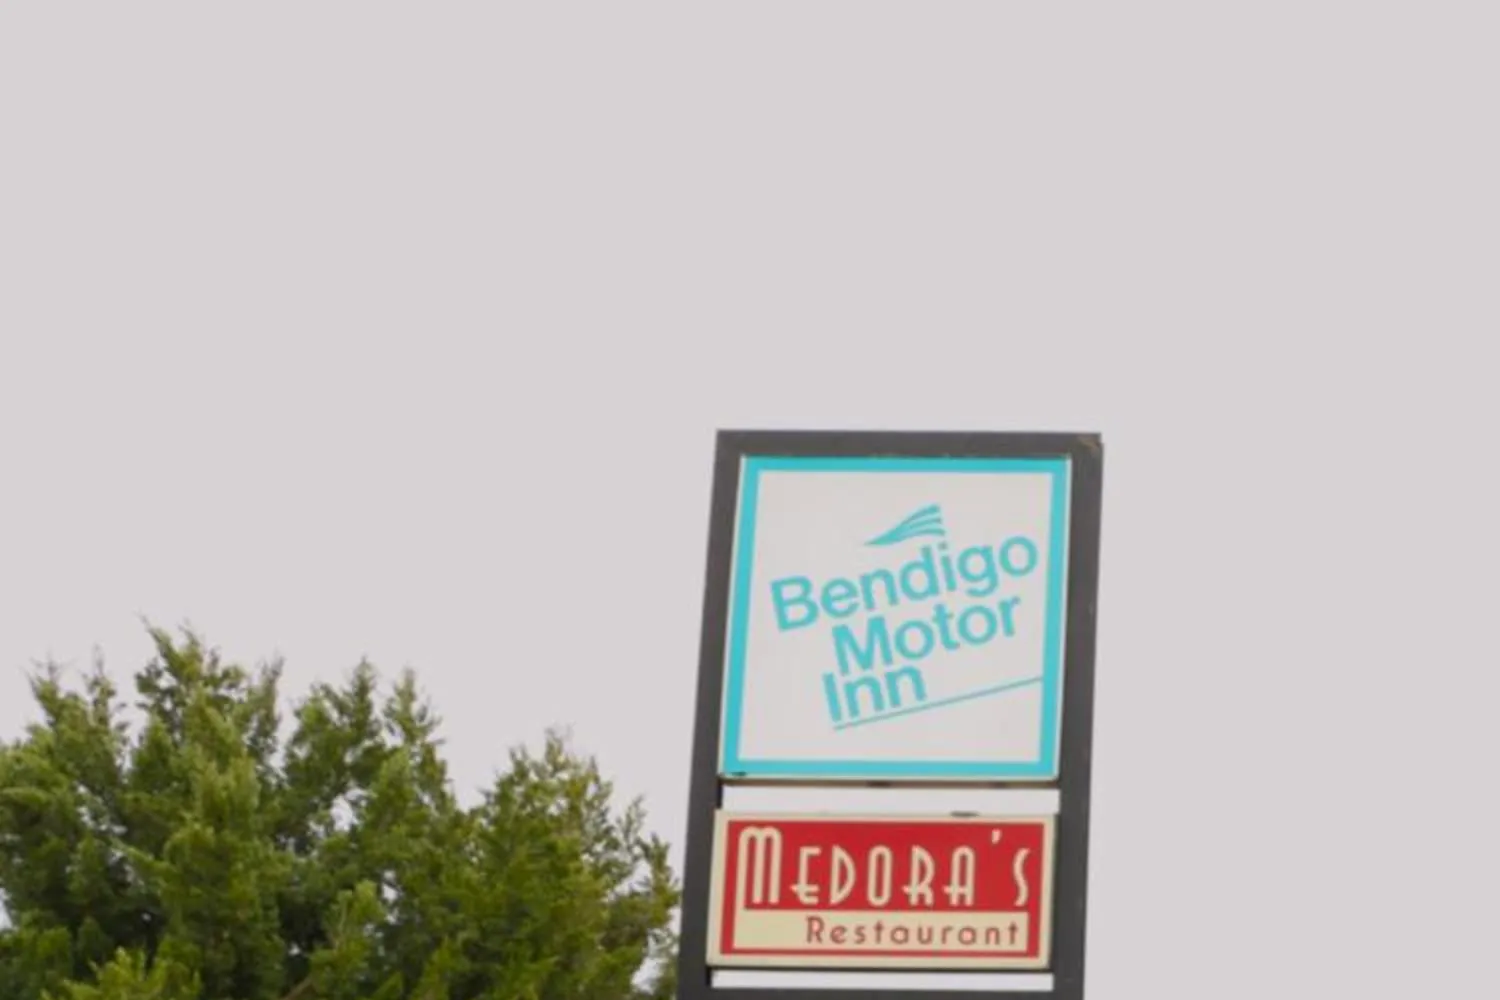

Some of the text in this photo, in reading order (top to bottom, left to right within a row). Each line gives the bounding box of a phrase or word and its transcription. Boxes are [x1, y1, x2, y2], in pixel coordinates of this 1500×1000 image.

[769, 535, 1039, 633] Bendigo
[831, 596, 1021, 677] Motor
[822, 665, 928, 722] Inn
[737, 826, 1031, 907] MEDORA'S
[805, 915, 1020, 946] Restaurant
